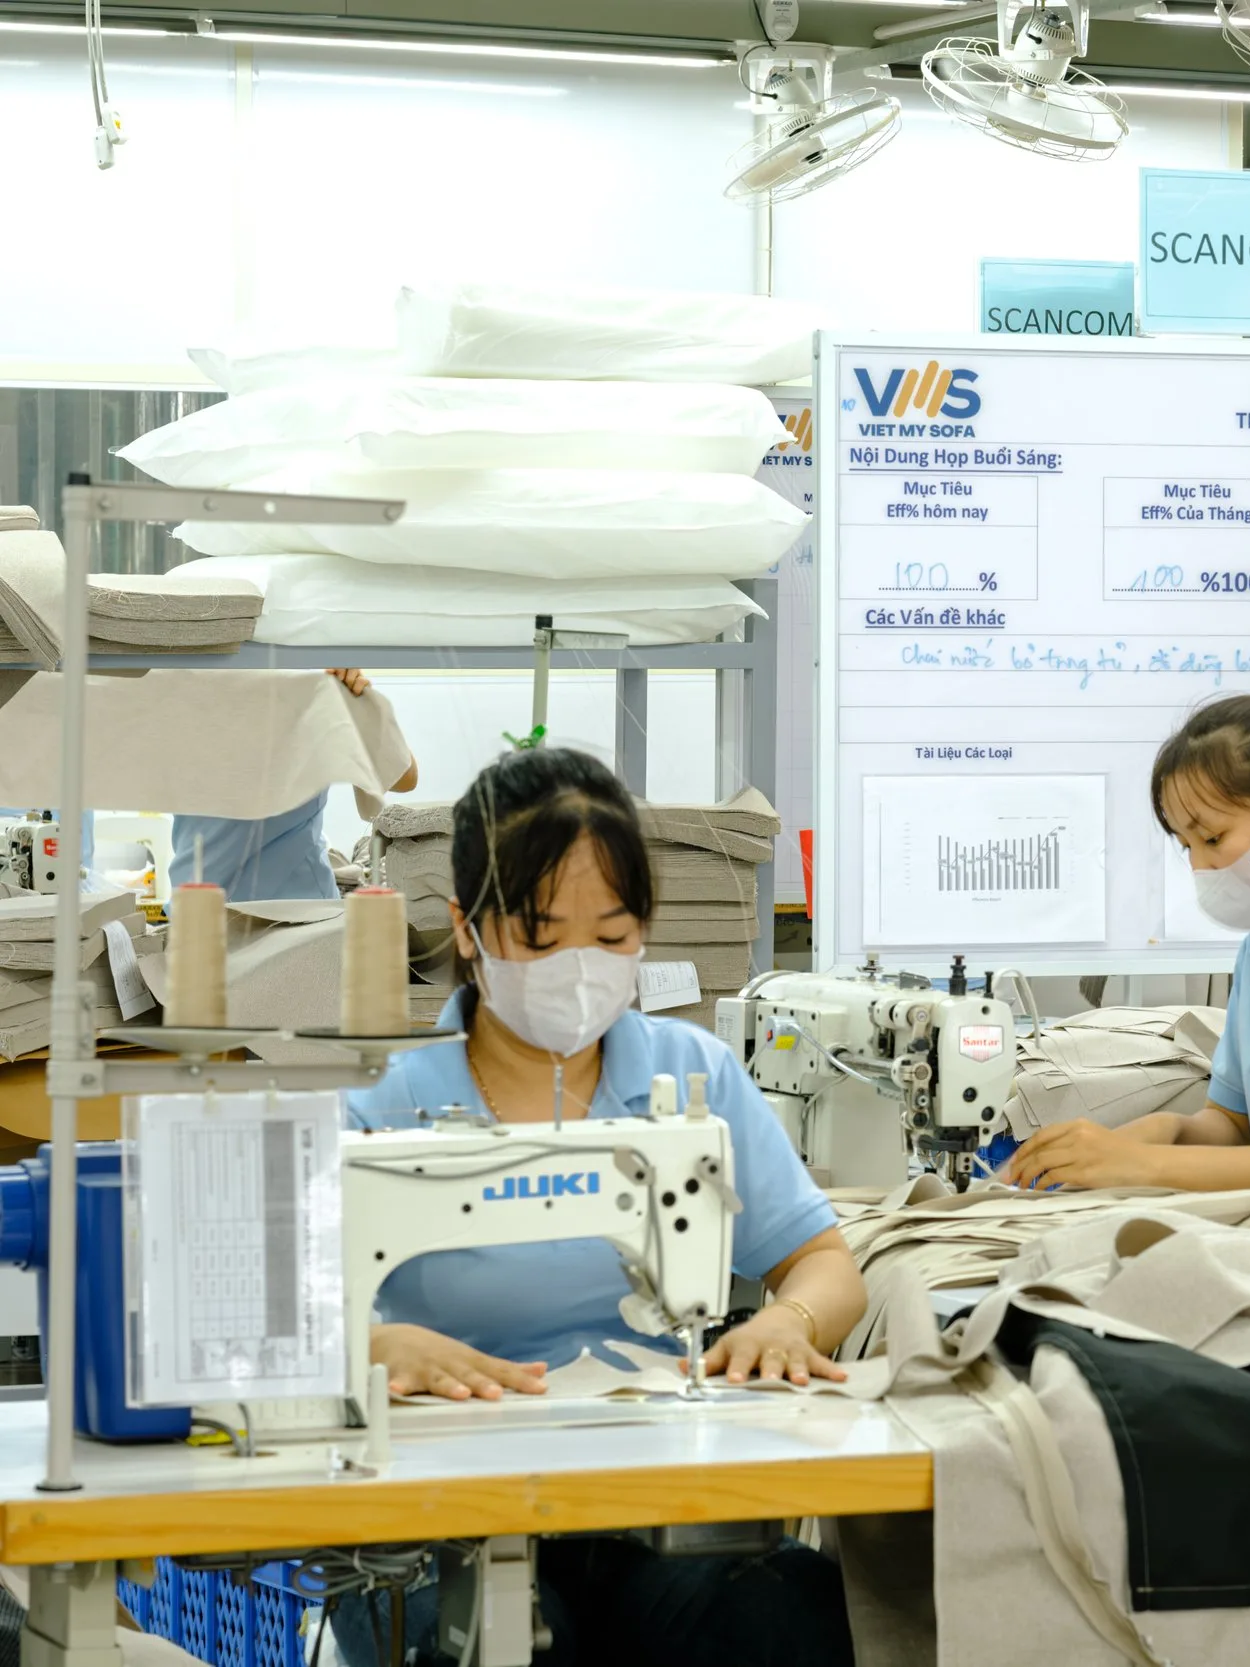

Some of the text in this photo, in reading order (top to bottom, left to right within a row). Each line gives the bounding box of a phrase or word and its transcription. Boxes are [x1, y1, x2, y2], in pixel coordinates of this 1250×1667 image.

[987, 307, 1133, 337] SCANCOM
[859, 423, 975, 438] VIET MY SOFA
[782, 456, 802, 465] MY
[850, 446, 1062, 469] Nội Dung Họp Buổi Sáng:
[904, 481, 973, 498] Mục Tiêu
[1164, 483, 1231, 500] Mục Tiêu
[887, 503, 989, 522] Eff% hôm nay
[1141, 506, 1173, 521] Eff%
[1176, 504, 1205, 521] Của
[865, 606, 1006, 626] Các Vấn đề khác
[915, 746, 1013, 762] Tài Liệu Các Loại
[482, 1171, 601, 1201] JUKI
